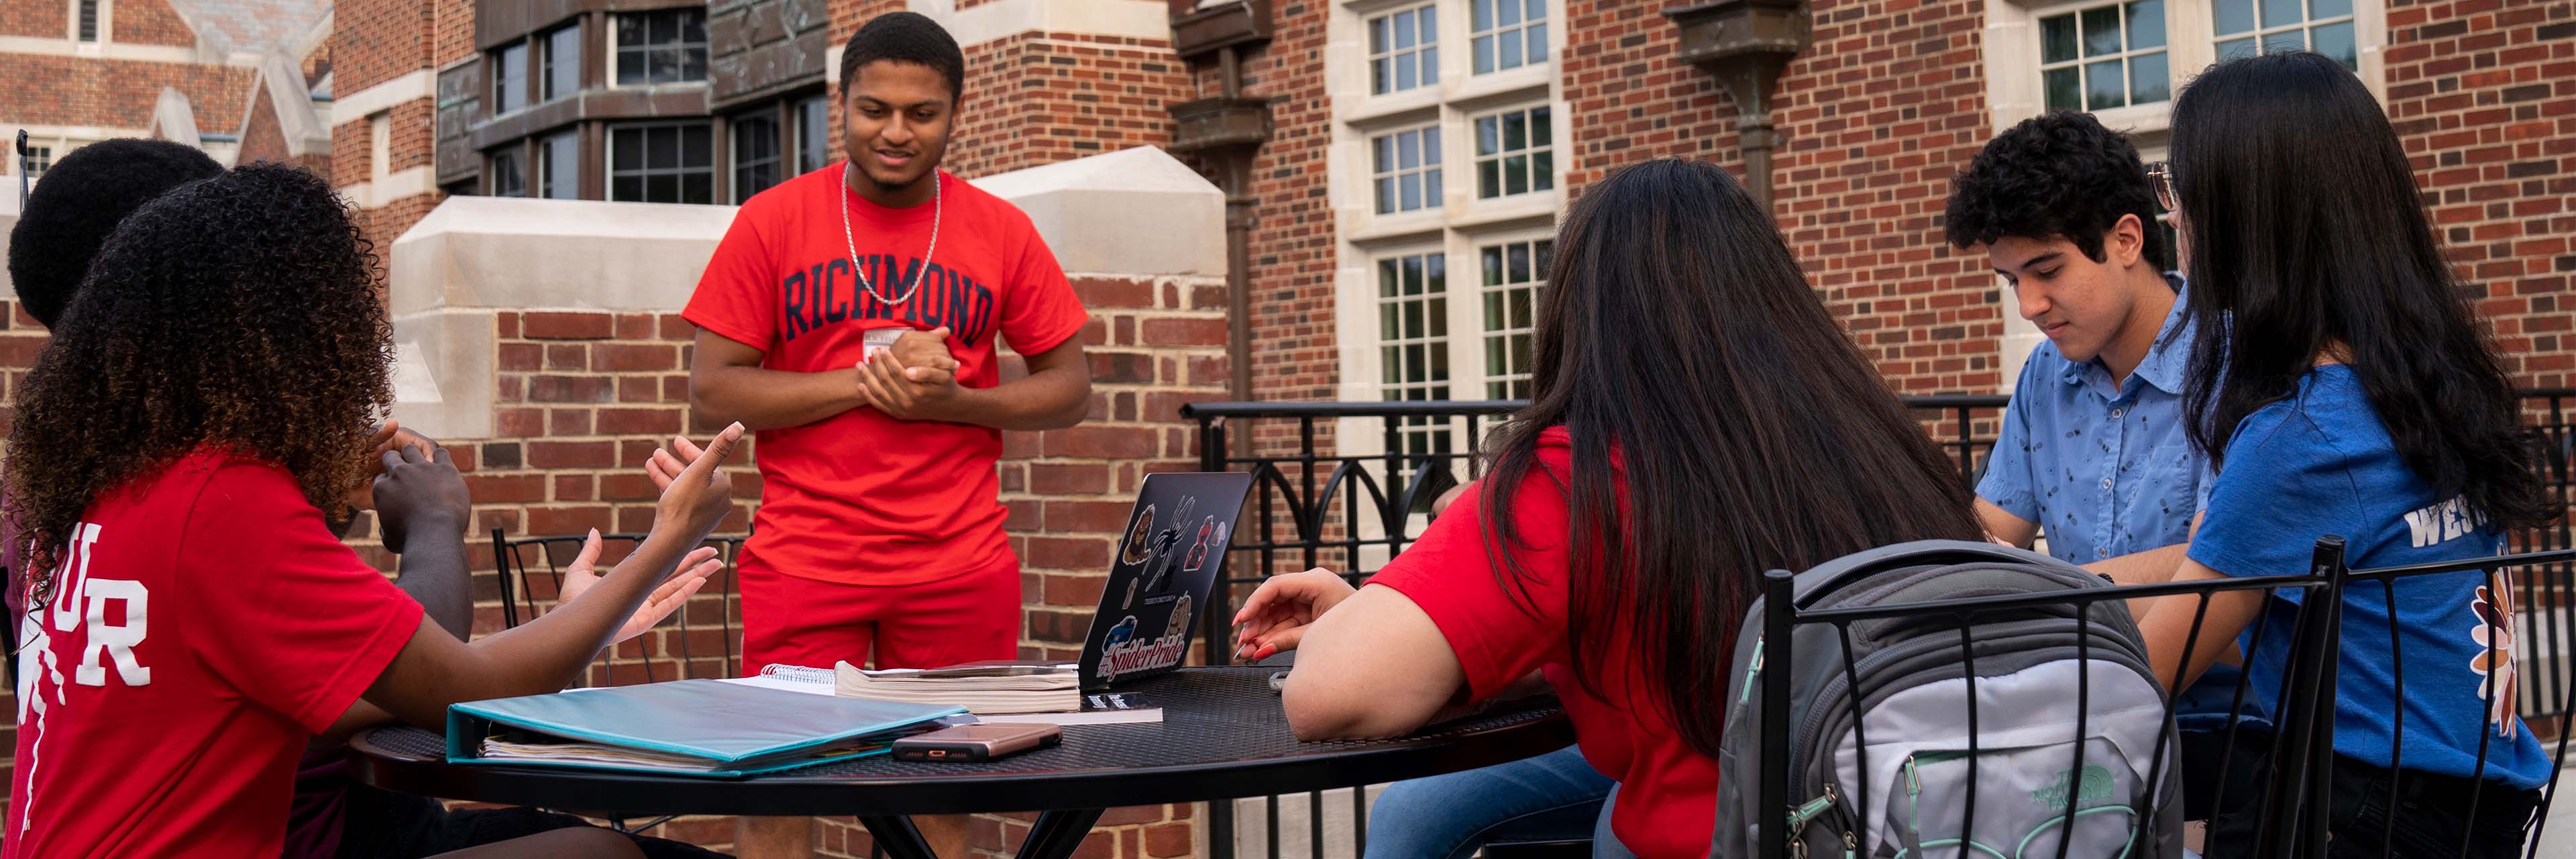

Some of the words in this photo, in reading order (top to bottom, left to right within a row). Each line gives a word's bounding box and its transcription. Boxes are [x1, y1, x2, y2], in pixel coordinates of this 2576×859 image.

[784, 254, 993, 348] RICHMOND
[2404, 493, 2487, 548] WES
[1098, 634, 1183, 680] #SpiderPride
